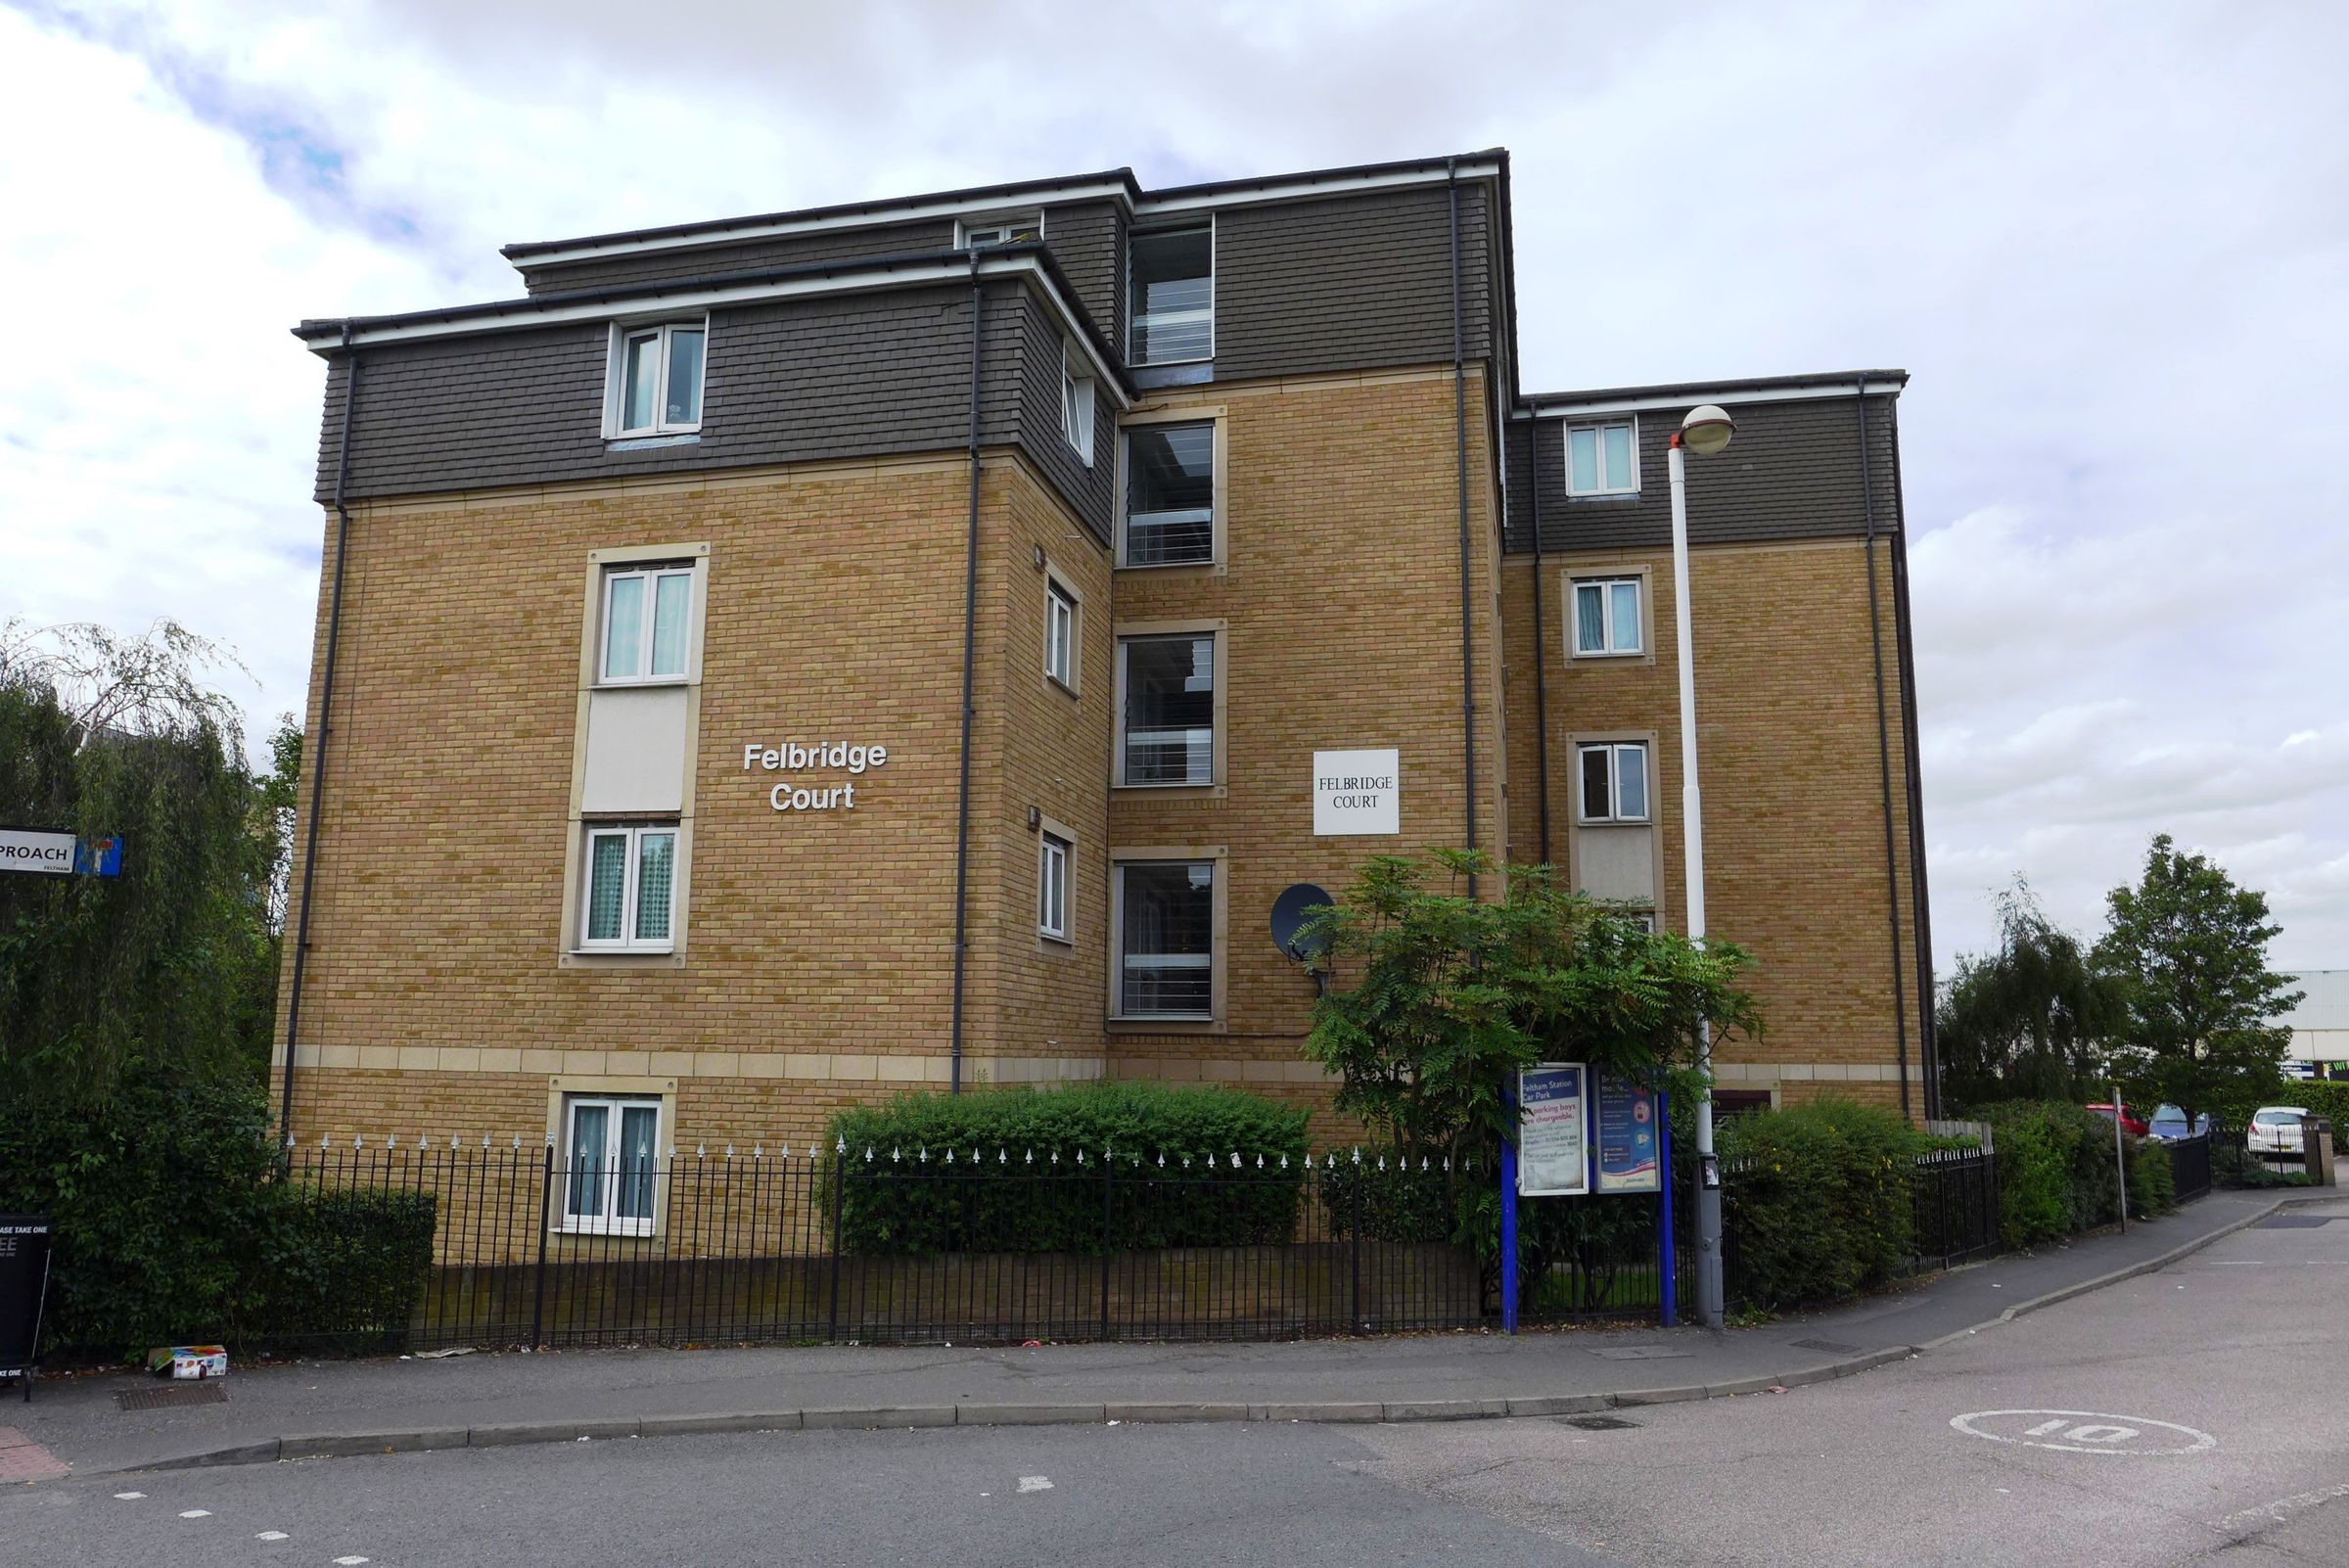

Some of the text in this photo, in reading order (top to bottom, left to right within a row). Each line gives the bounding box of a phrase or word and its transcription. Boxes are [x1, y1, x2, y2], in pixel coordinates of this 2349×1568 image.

[744, 740, 887, 774] Felbridge
[1319, 776, 1393, 791] FELBRIDGE
[770, 783, 854, 810] Court
[1333, 795, 1379, 808] COURT
[1548, 1080, 1573, 1089] Station
[1523, 1090, 1551, 1102] Car Park
[2024, 1418, 2141, 1443] 10
